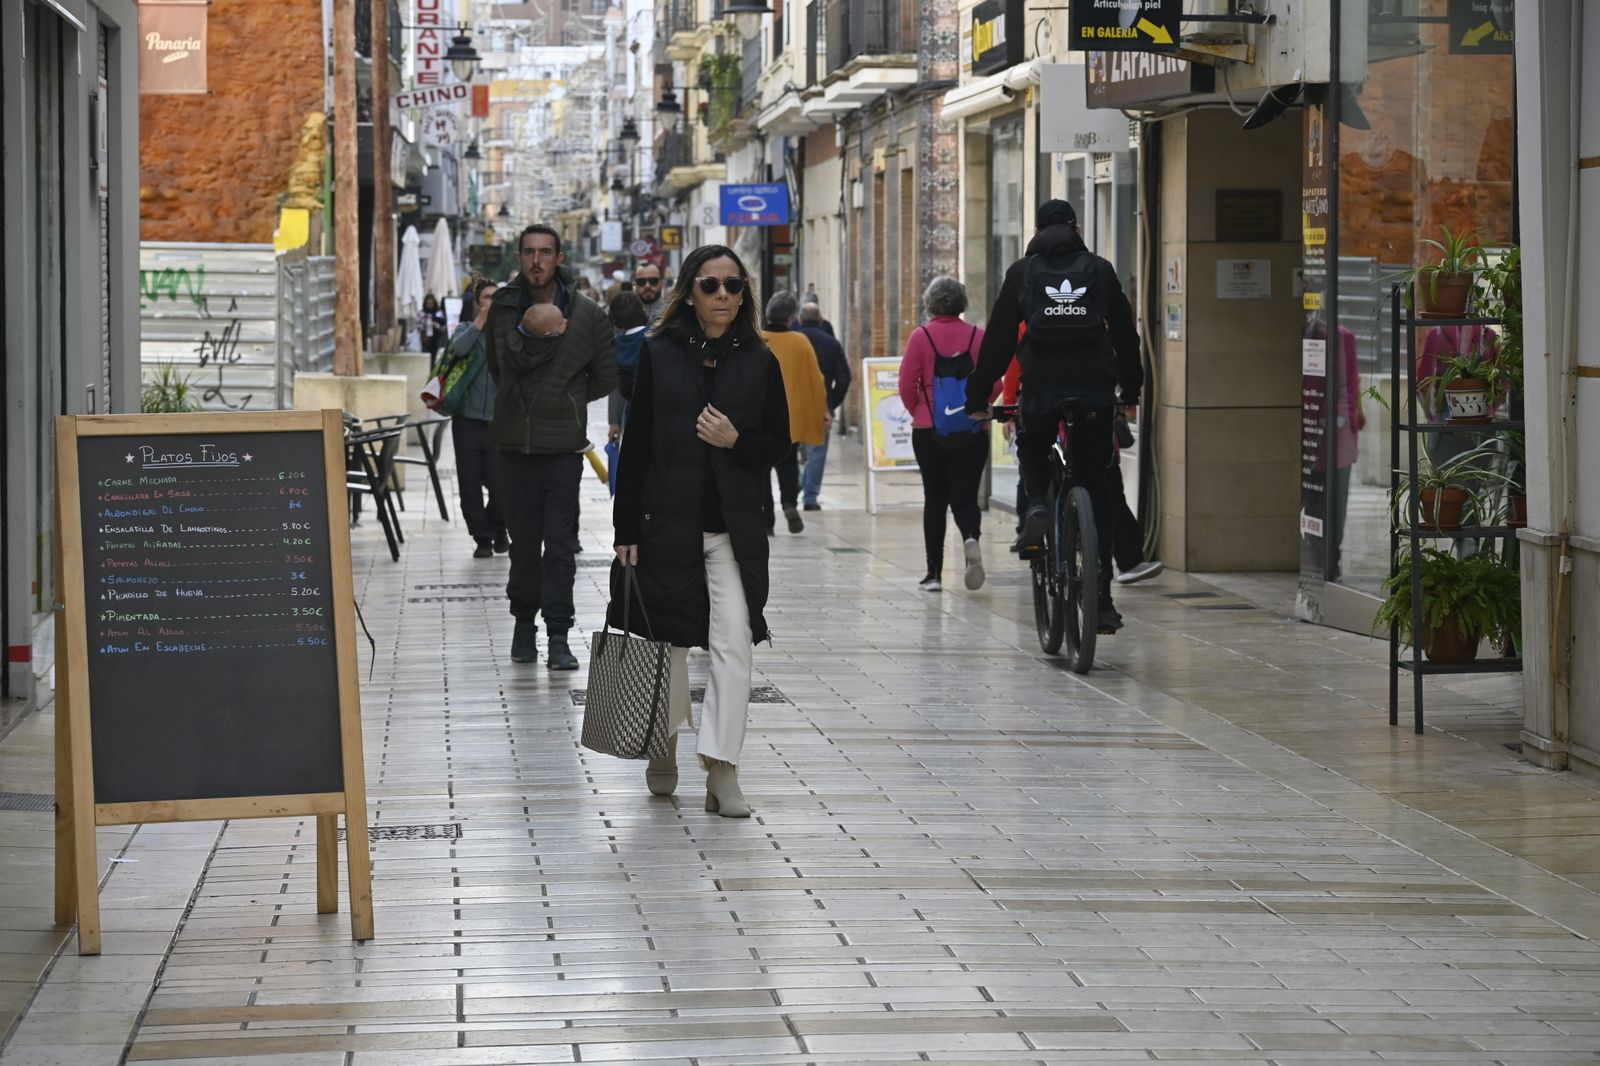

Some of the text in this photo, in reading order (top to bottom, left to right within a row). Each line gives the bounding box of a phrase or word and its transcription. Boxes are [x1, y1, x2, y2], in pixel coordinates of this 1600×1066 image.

[1081, 27, 1095, 38] EN
[145, 31, 201, 50] Panaria
[396, 84, 467, 109] CHINO
[1044, 304, 1087, 316] adidas
[139, 446, 192, 463] PLATOS
[162, 506, 173, 514] DE
[161, 525, 173, 533] DE
[291, 588, 320, 596] 5.20€
[106, 608, 324, 621] PIMENTADA 3.50€
